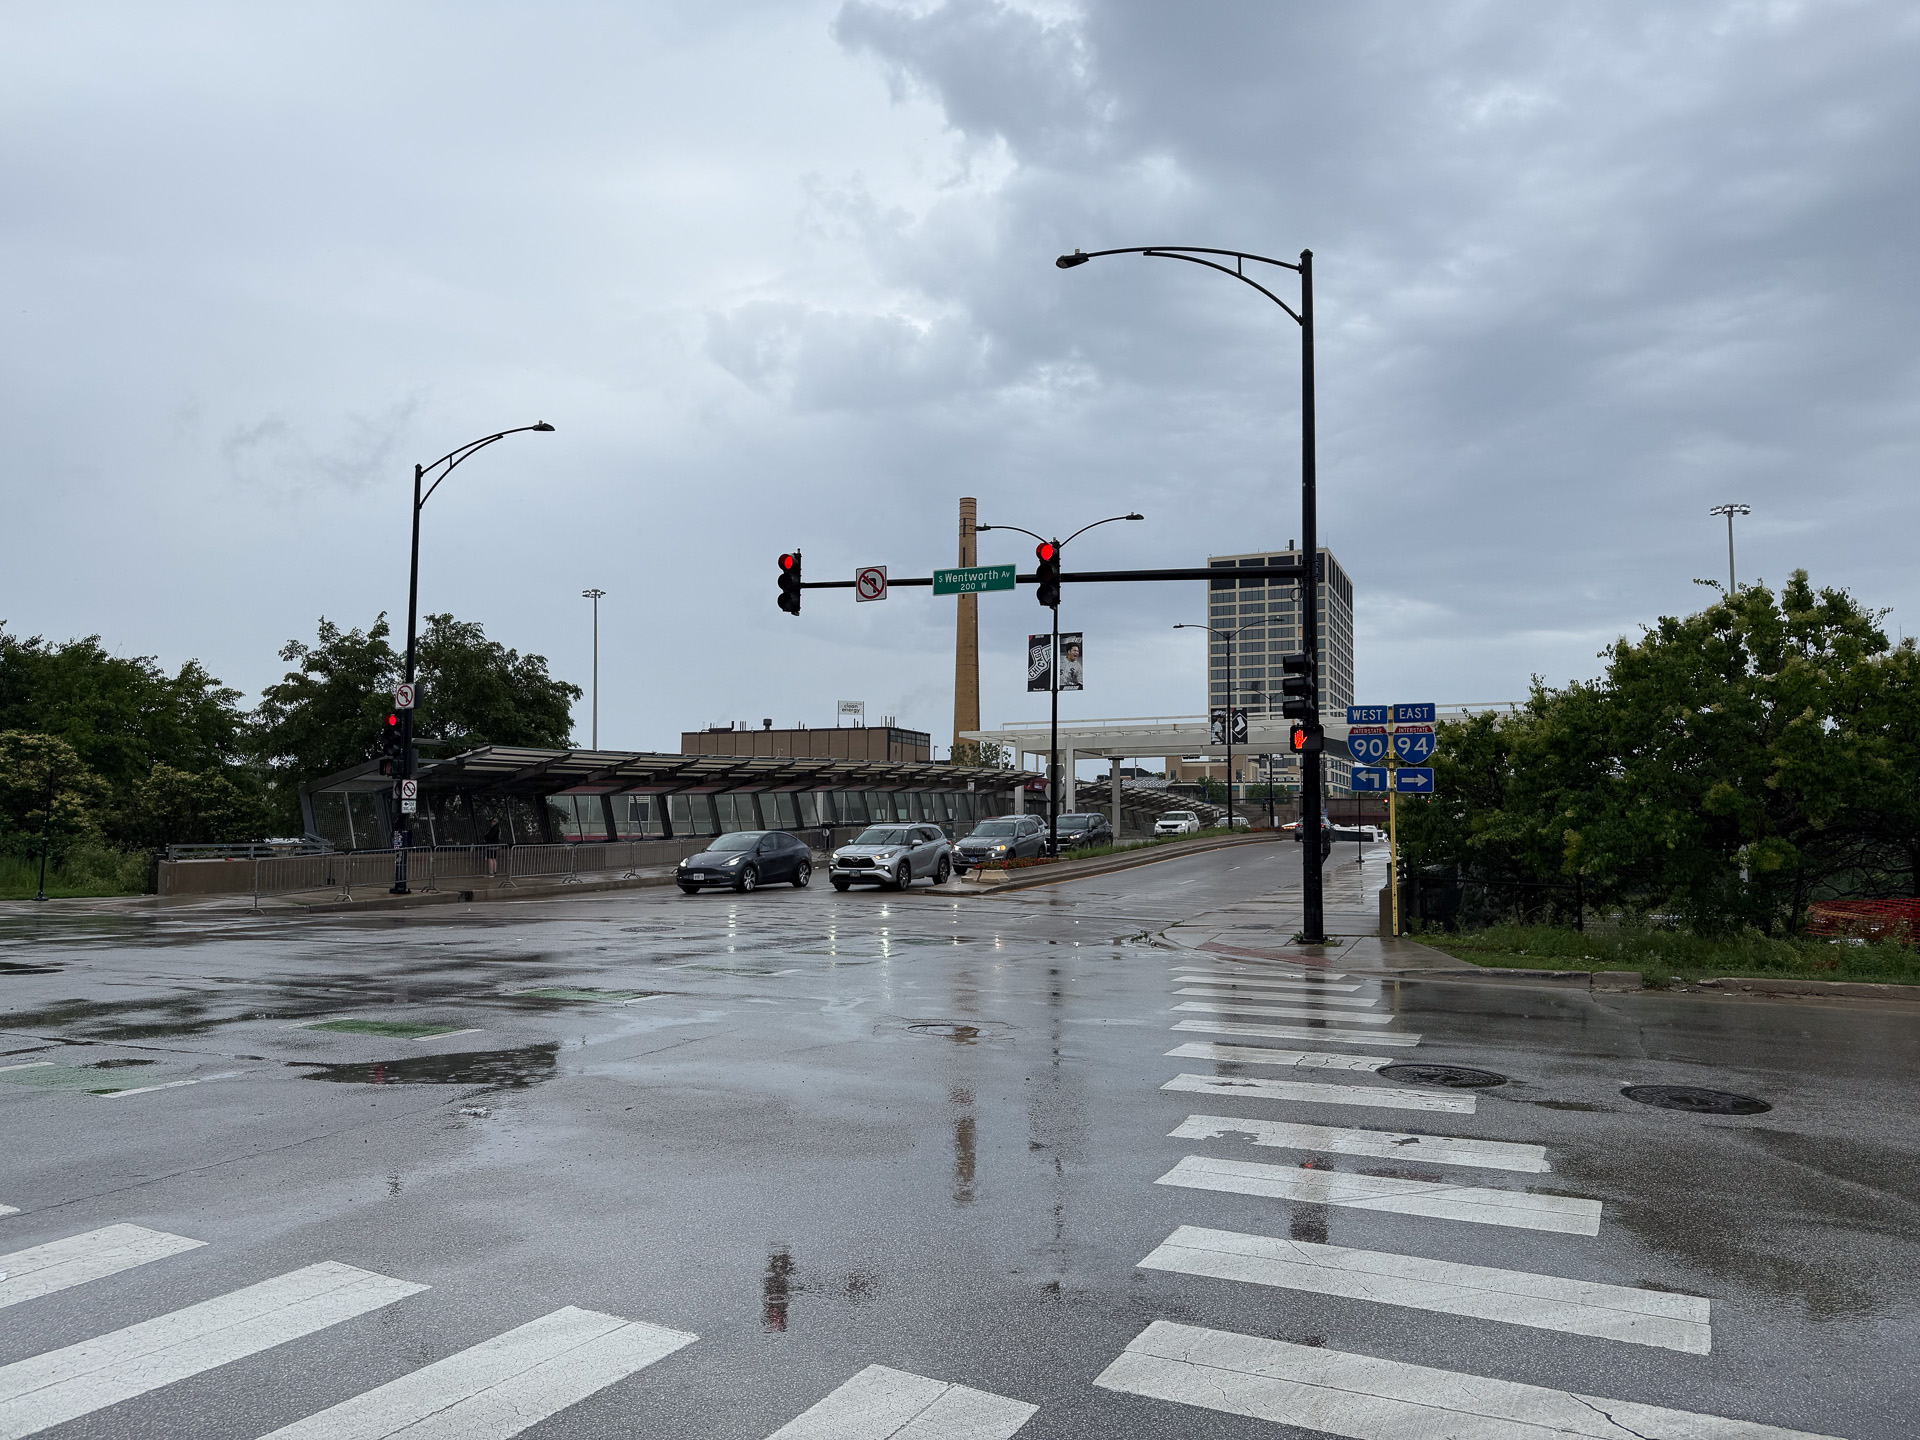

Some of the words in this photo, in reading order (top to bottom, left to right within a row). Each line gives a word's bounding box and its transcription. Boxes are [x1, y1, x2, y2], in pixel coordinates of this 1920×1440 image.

[938, 575, 943, 583] S
[945, 569, 999, 583] Wentworth
[1001, 570, 1011, 578] Av
[960, 582, 976, 591] 200
[981, 581, 988, 589] W
[1028, 649, 1044, 678] CHICAGO
[1352, 709, 1383, 721] WEST
[1399, 707, 1429, 719] EAST
[1354, 738, 1383, 757] 90
[1397, 737, 1429, 755] 94
